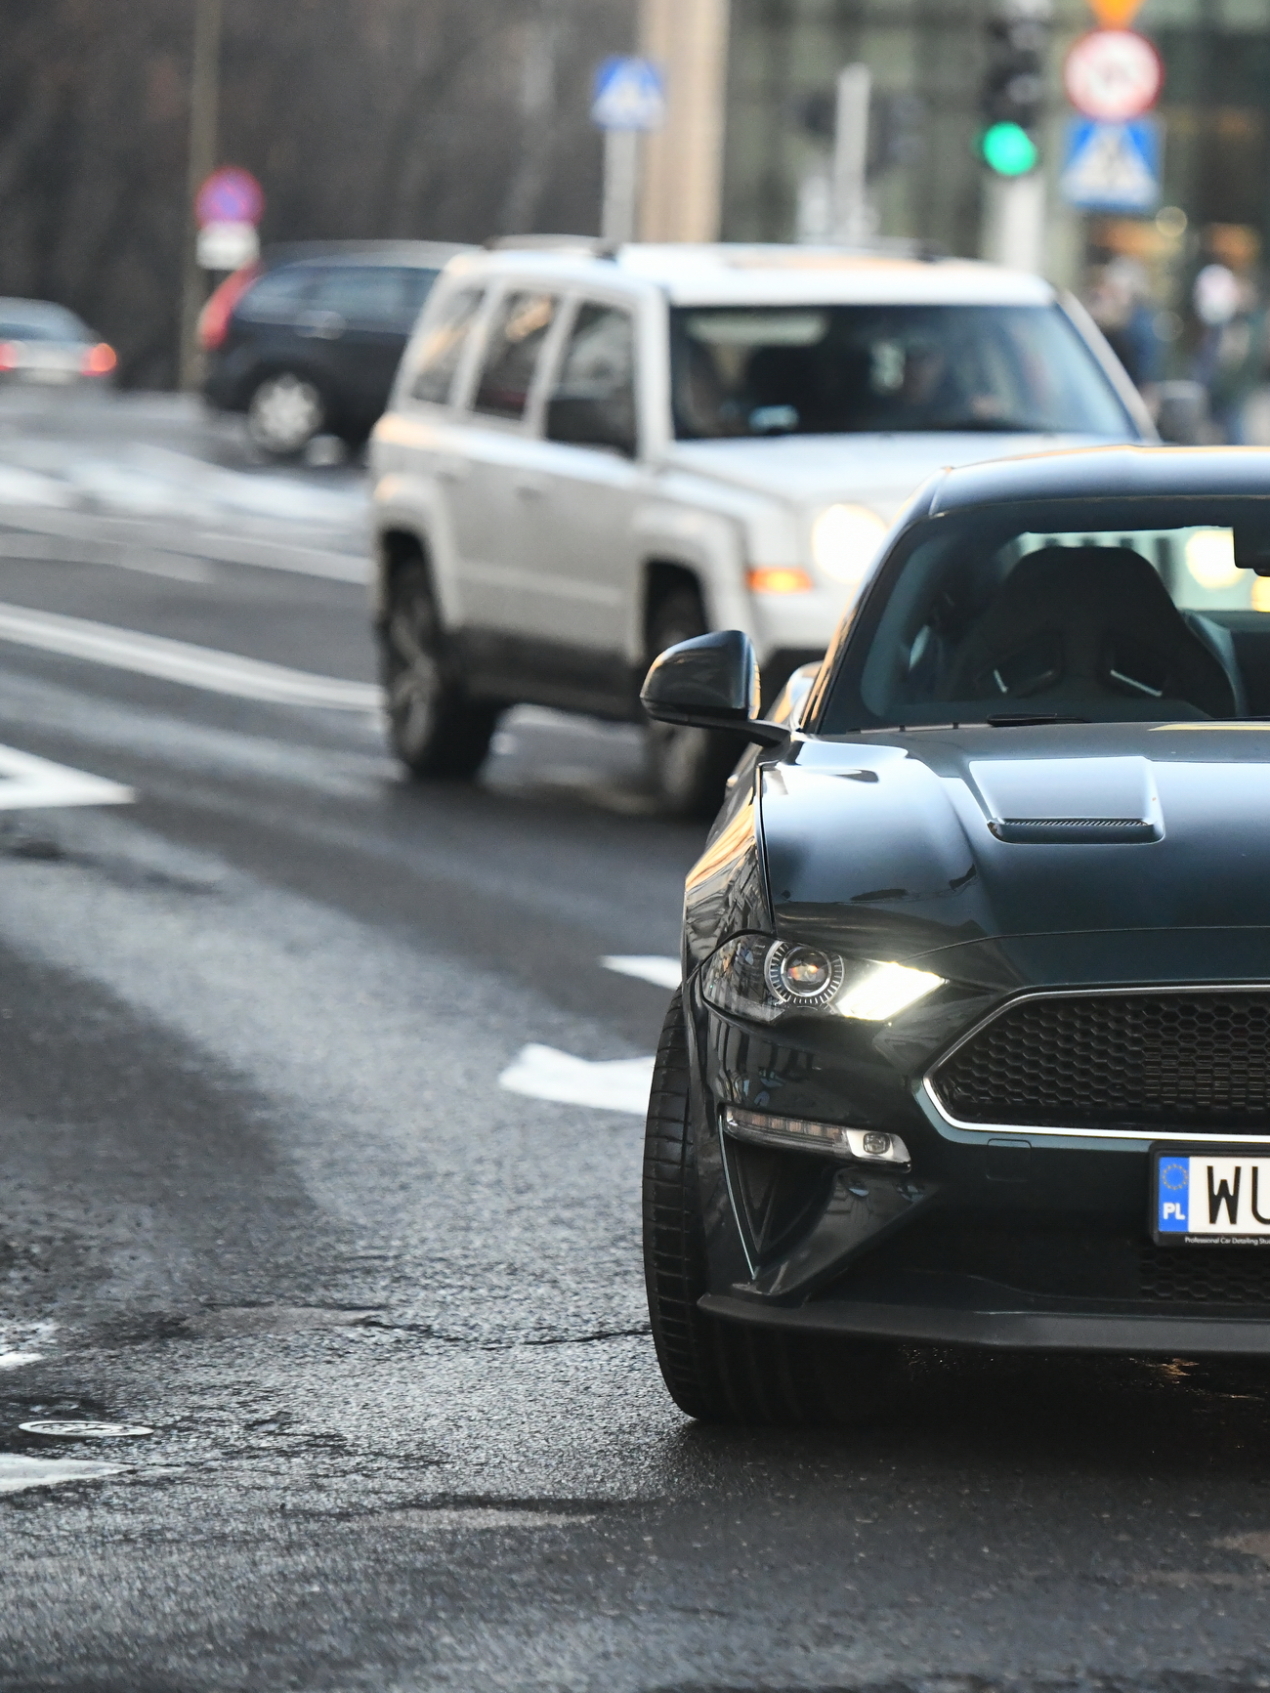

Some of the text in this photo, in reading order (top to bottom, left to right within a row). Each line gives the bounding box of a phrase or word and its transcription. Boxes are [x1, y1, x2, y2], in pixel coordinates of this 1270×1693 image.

[1162, 1201, 1186, 1221] PL
[1184, 1236, 1219, 1245] Professional
[1220, 1236, 1231, 1245] Car
[1232, 1237, 1259, 1246] Detailing
